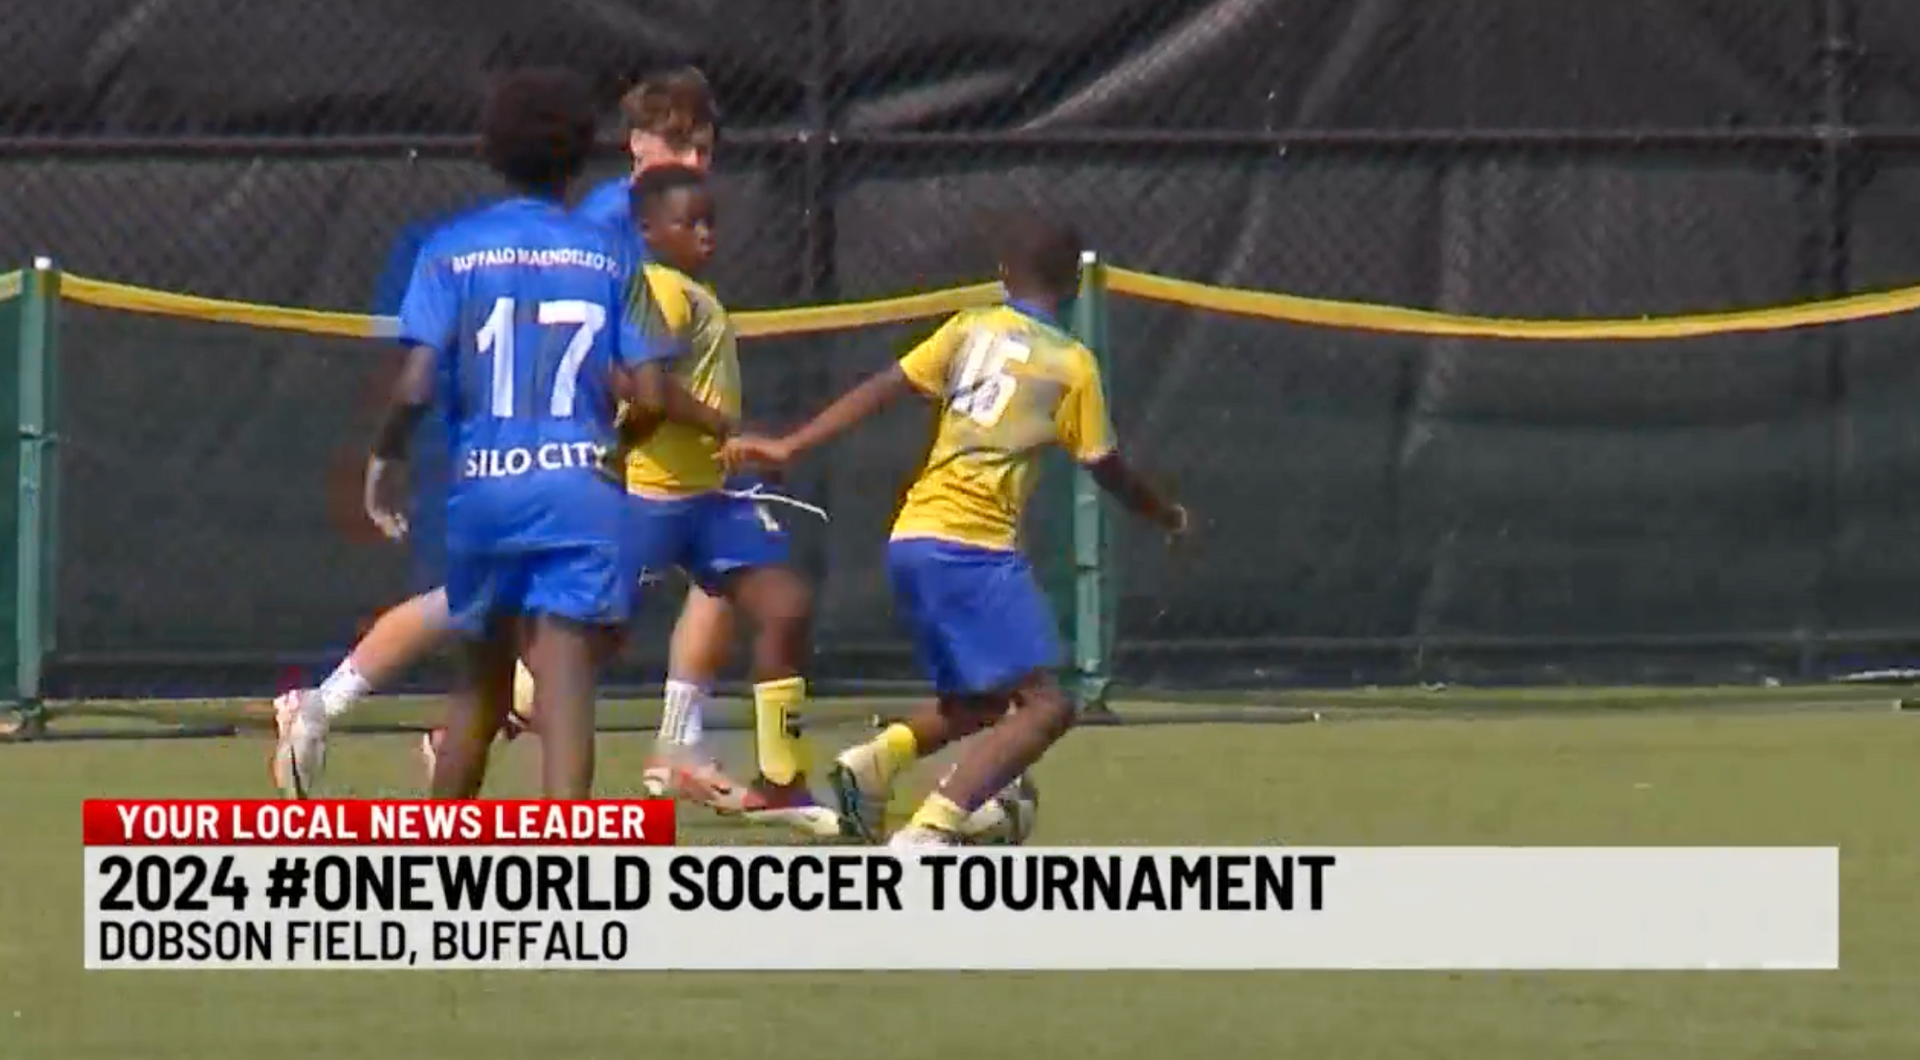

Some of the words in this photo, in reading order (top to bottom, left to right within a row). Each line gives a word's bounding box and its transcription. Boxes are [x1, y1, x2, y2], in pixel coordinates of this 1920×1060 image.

[452, 247, 515, 273] BUFFALO
[476, 297, 606, 418] 17
[465, 448, 531, 477] SILO
[538, 442, 607, 469] CITY
